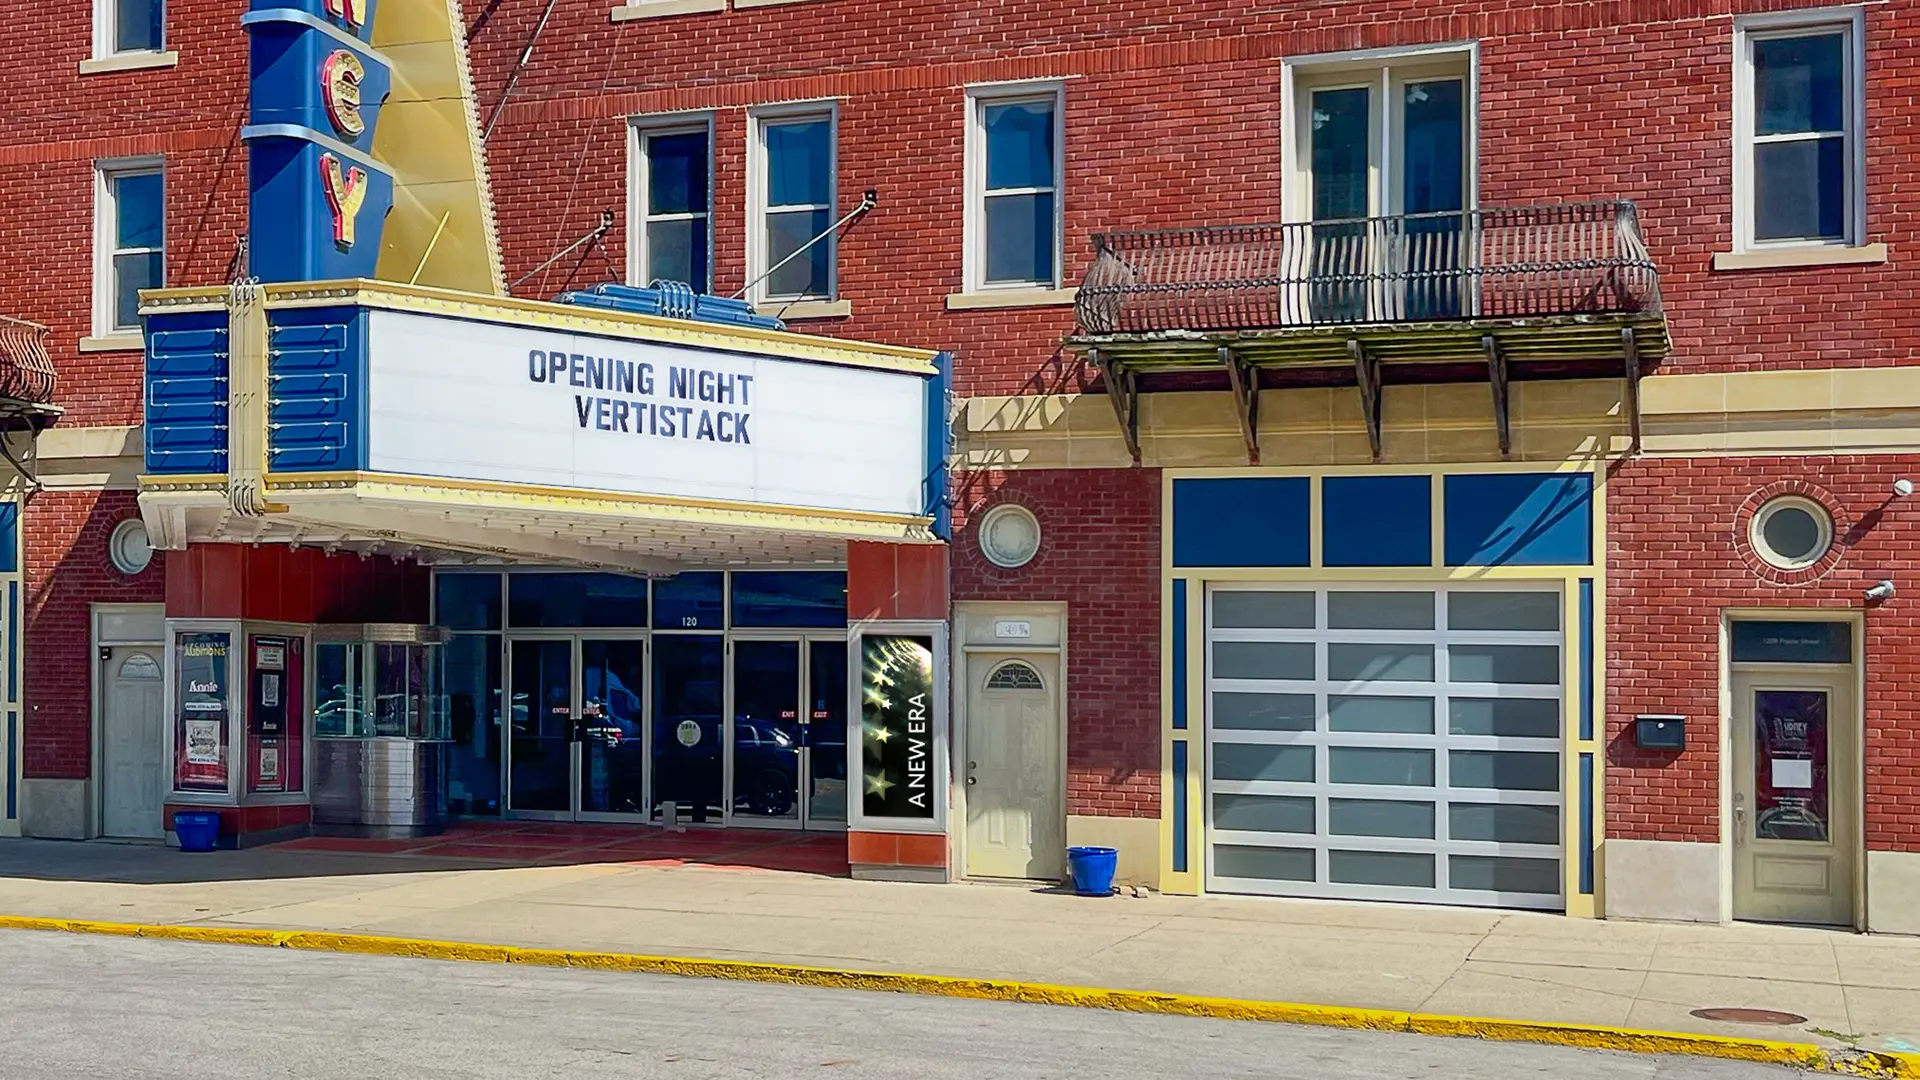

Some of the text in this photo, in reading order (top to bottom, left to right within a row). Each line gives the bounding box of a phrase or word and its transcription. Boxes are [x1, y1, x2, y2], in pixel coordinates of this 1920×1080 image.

[529, 350, 754, 406] OPENING NIGHT
[574, 394, 751, 445] VERTISTACK
[682, 616, 697, 627] 120
[184, 647, 226, 656] AUDITIONS
[189, 680, 218, 692] Annie
[908, 692, 926, 808] A NEW ERA
